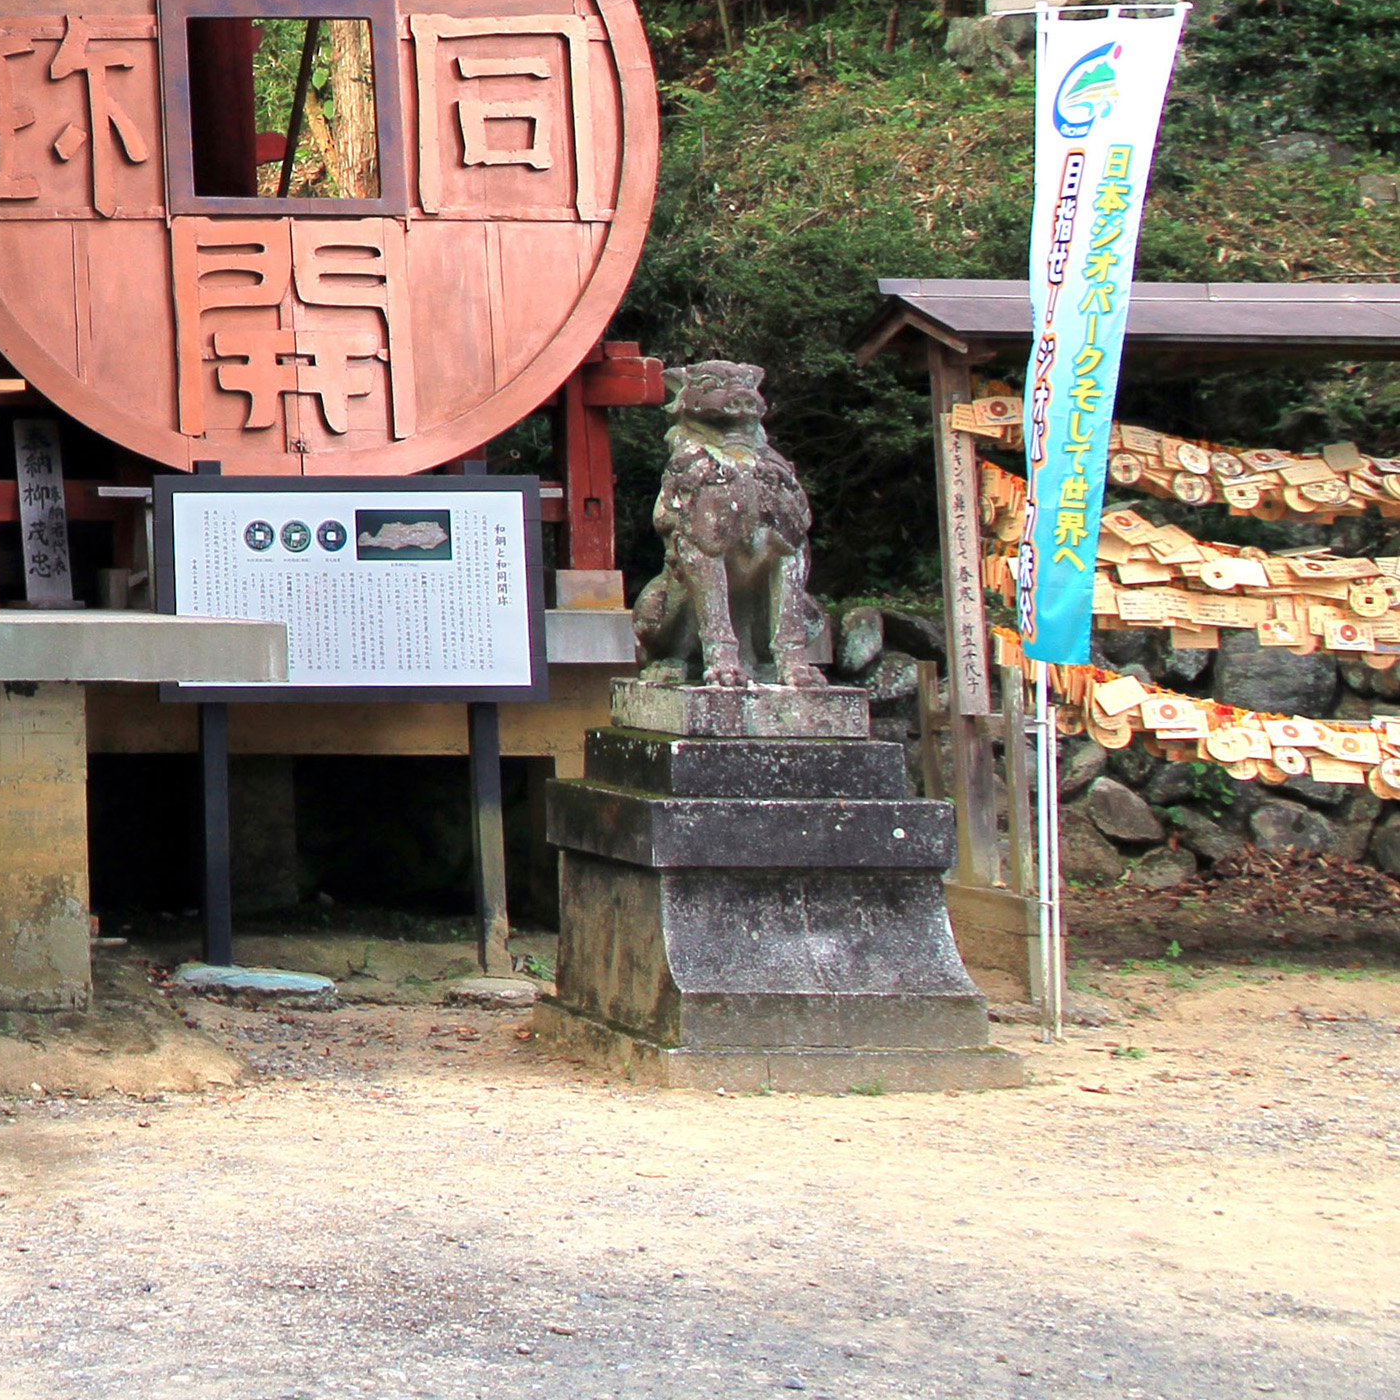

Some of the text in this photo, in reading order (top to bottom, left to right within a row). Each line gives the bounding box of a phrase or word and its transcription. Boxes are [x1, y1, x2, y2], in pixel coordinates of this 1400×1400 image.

[411, 14, 596, 219] 同
[172, 216, 415, 441] 開
[1054, 145, 1133, 572] 日本ジオパークそして世界へ
